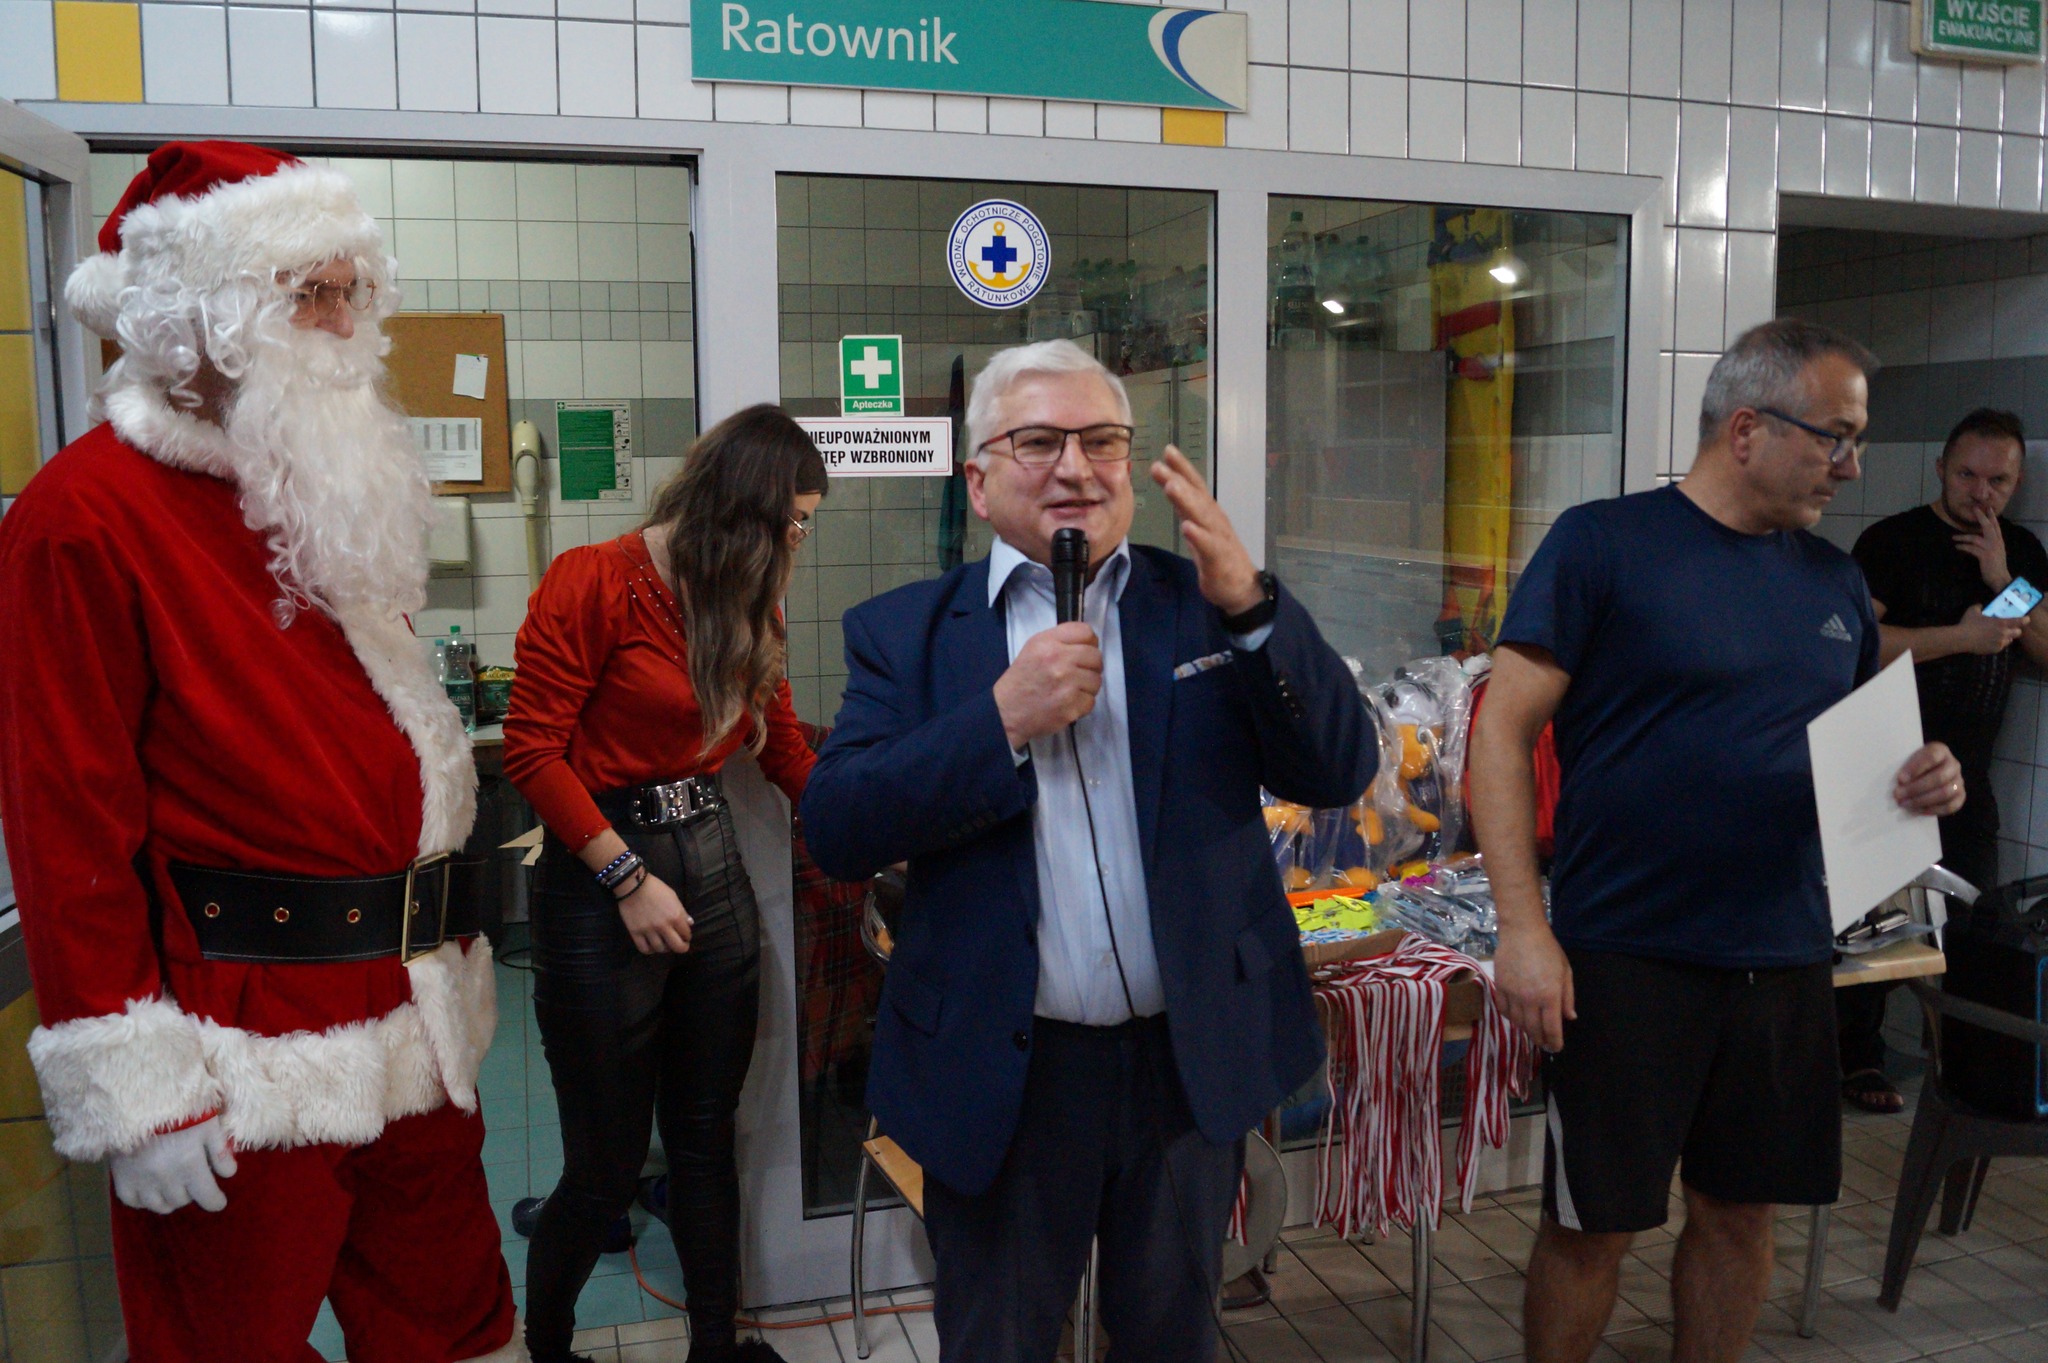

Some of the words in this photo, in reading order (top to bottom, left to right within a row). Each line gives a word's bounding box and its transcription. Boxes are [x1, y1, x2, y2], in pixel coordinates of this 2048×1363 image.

[722, 2, 959, 65] Ratownik
[953, 237, 967, 279] WODNE
[960, 206, 1022, 234] OCHOTNICZE
[1021, 217, 1045, 281] POGOTOWIE
[967, 280, 1033, 302] RATUNKOWE
[852, 400, 893, 411] Apteczka
[820, 450, 846, 467] TĘP
[850, 449, 935, 464] WZBRONIONY
